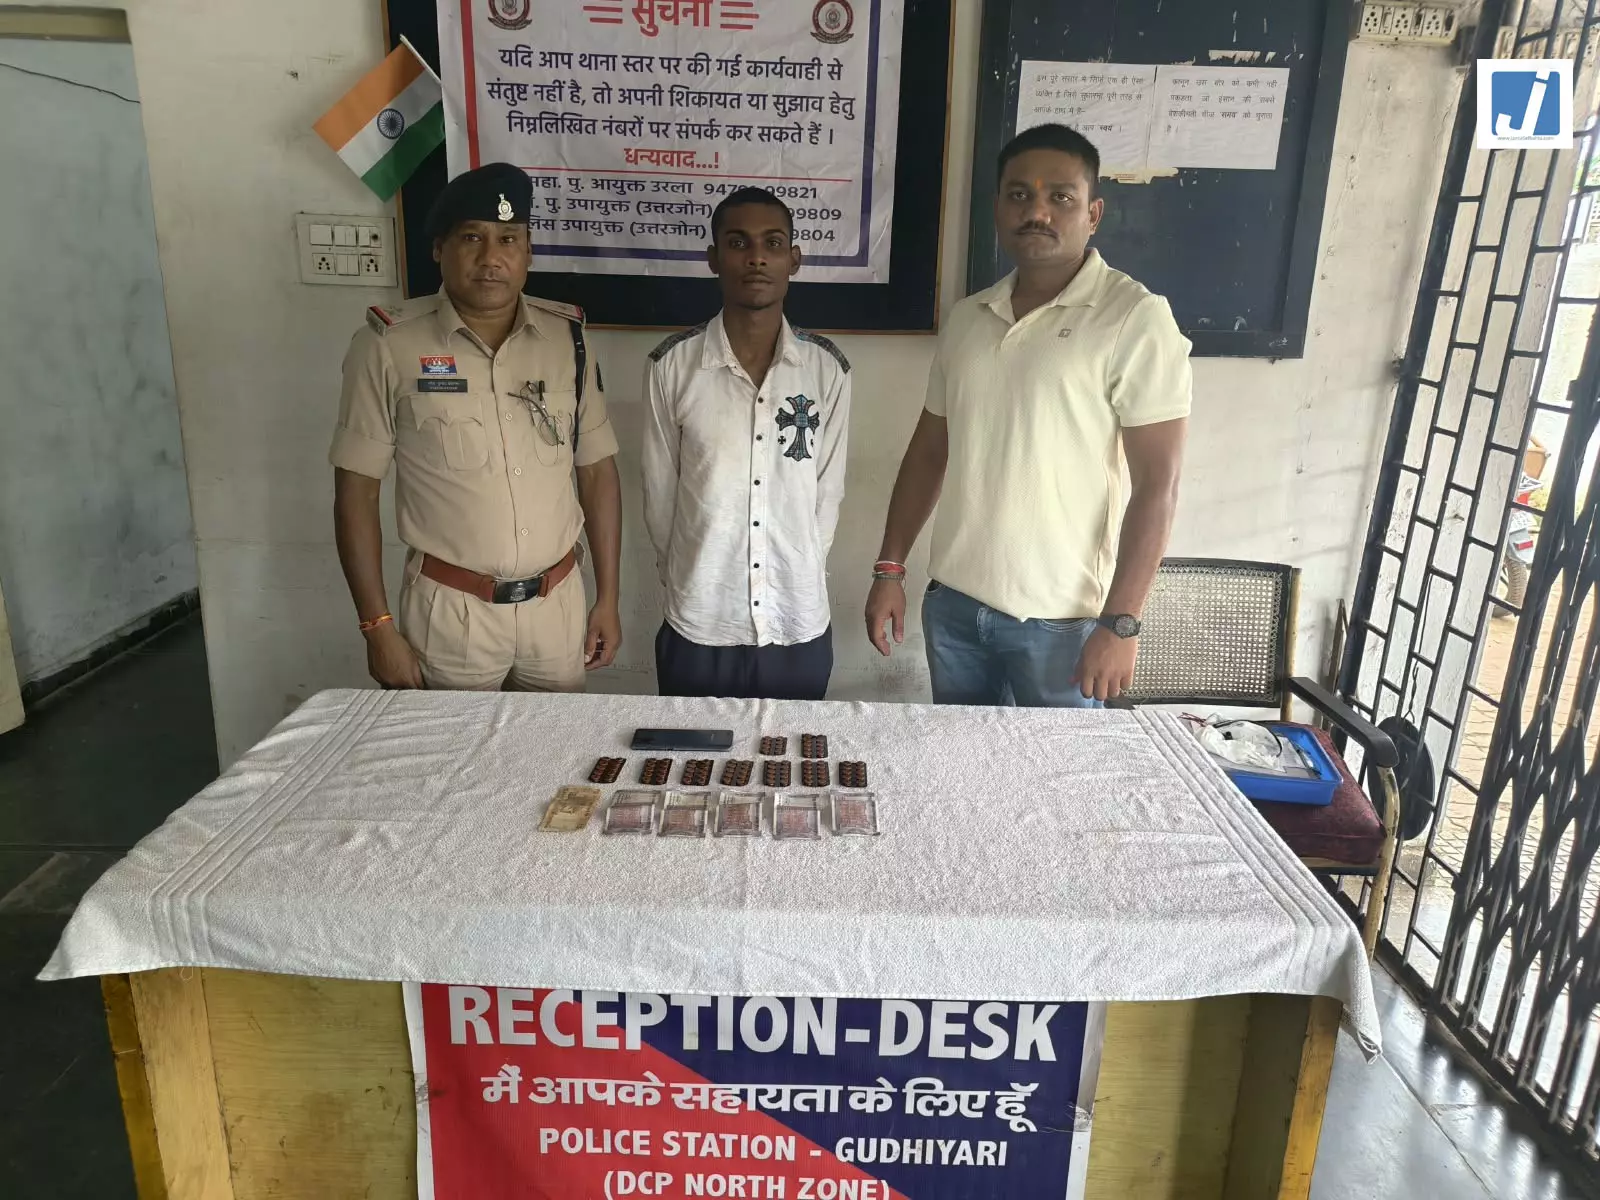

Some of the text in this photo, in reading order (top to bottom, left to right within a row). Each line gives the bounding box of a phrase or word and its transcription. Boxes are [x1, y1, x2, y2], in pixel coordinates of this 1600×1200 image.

[498, 44, 843, 81] यदि आप थाना स्तर पर की गई कार्यवाही से
[486, 78, 856, 120] संतुष्ट नहीं है, तो अपनी शिकायत या सुझाव हेतु
[506, 110, 598, 135] निम्नलिखित
[602, 115, 643, 137] नंबरों
[648, 122, 671, 139] पर
[675, 118, 721, 140] संपर्क
[725, 124, 753, 141] कर
[757, 121, 803, 143] सकते
[808, 121, 822, 145] हैं
[624, 148, 719, 169] धन्यवाद...!
[567, 177, 585, 193] पु.
[591, 178, 646, 195] आयुक्त
[651, 180, 693, 194] उरला
[544, 198, 562, 213] पु.
[567, 198, 631, 215] उपायुक्त
[636, 200, 713, 219] (उत्तरजोन)
[561, 219, 625, 237] उपायुक्त
[629, 220, 707, 239] (उत्तरजोन)
[449, 986, 1060, 1061] RECEPTION-DESK
[528, 1071, 665, 1106] आपके
[670, 1083, 843, 1114] सहायता
[848, 1077, 897, 1113] के
[902, 1077, 990, 1118] लिए
[539, 1127, 651, 1156] POLICE
[662, 1130, 795, 1161] STATION
[835, 1137, 1008, 1167] GUDHIYARI
[603, 1170, 890, 1200] (DCP NORTH ZONE)
